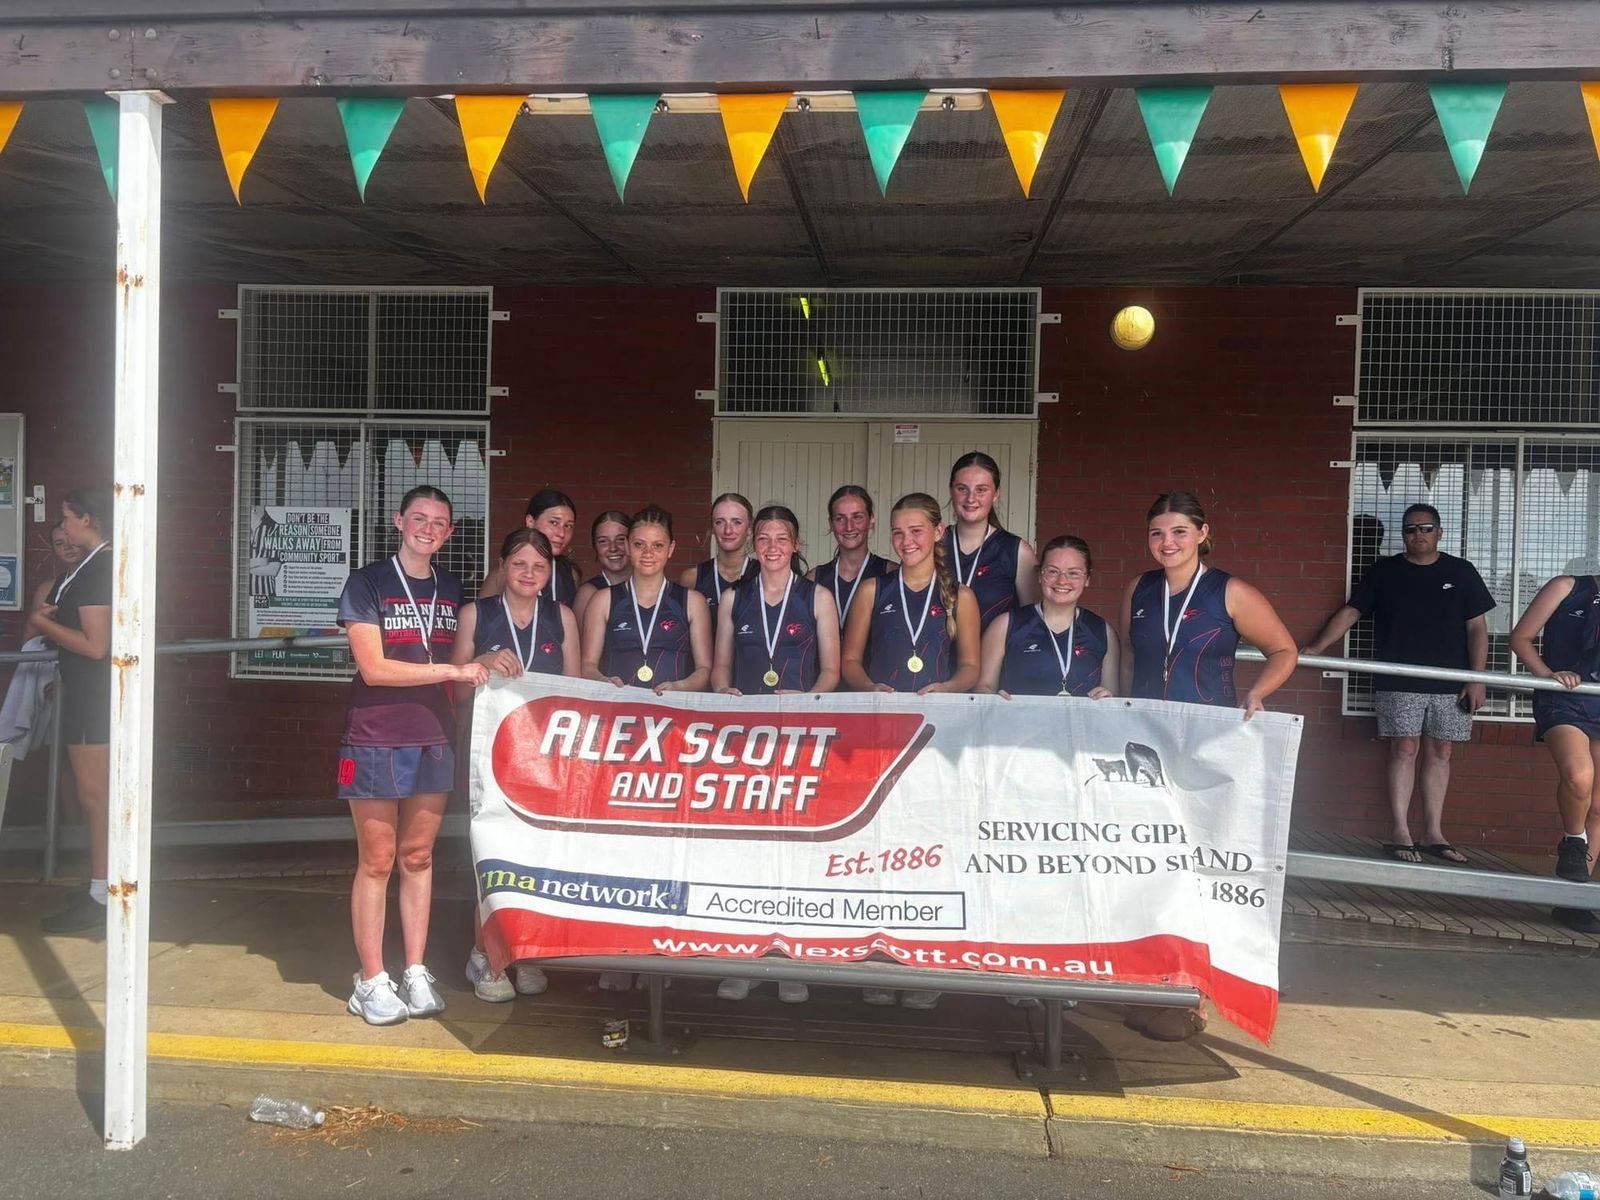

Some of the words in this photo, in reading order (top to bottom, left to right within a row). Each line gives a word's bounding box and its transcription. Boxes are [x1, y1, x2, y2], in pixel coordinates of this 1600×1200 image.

[307, 513, 315, 523] BE
[316, 513, 329, 523] THE
[280, 524, 308, 536] REASON
[310, 525, 340, 536] SOMEONE
[264, 537, 294, 550] WALKS
[296, 537, 321, 551] AWAY
[323, 539, 341, 550] FROM
[280, 552, 318, 562] COMMUNITY
[540, 710, 674, 763] ALEX
[678, 722, 838, 768] SCOTT
[610, 772, 684, 800] AND
[690, 774, 821, 811] STAFF
[978, 821, 1121, 843] SERVICING
[964, 853, 1027, 874] AND
[1038, 854, 1157, 875] BEYOND
[1211, 881, 1267, 908] 1886
[706, 891, 834, 919] Accredited
[843, 898, 944, 921] Member
